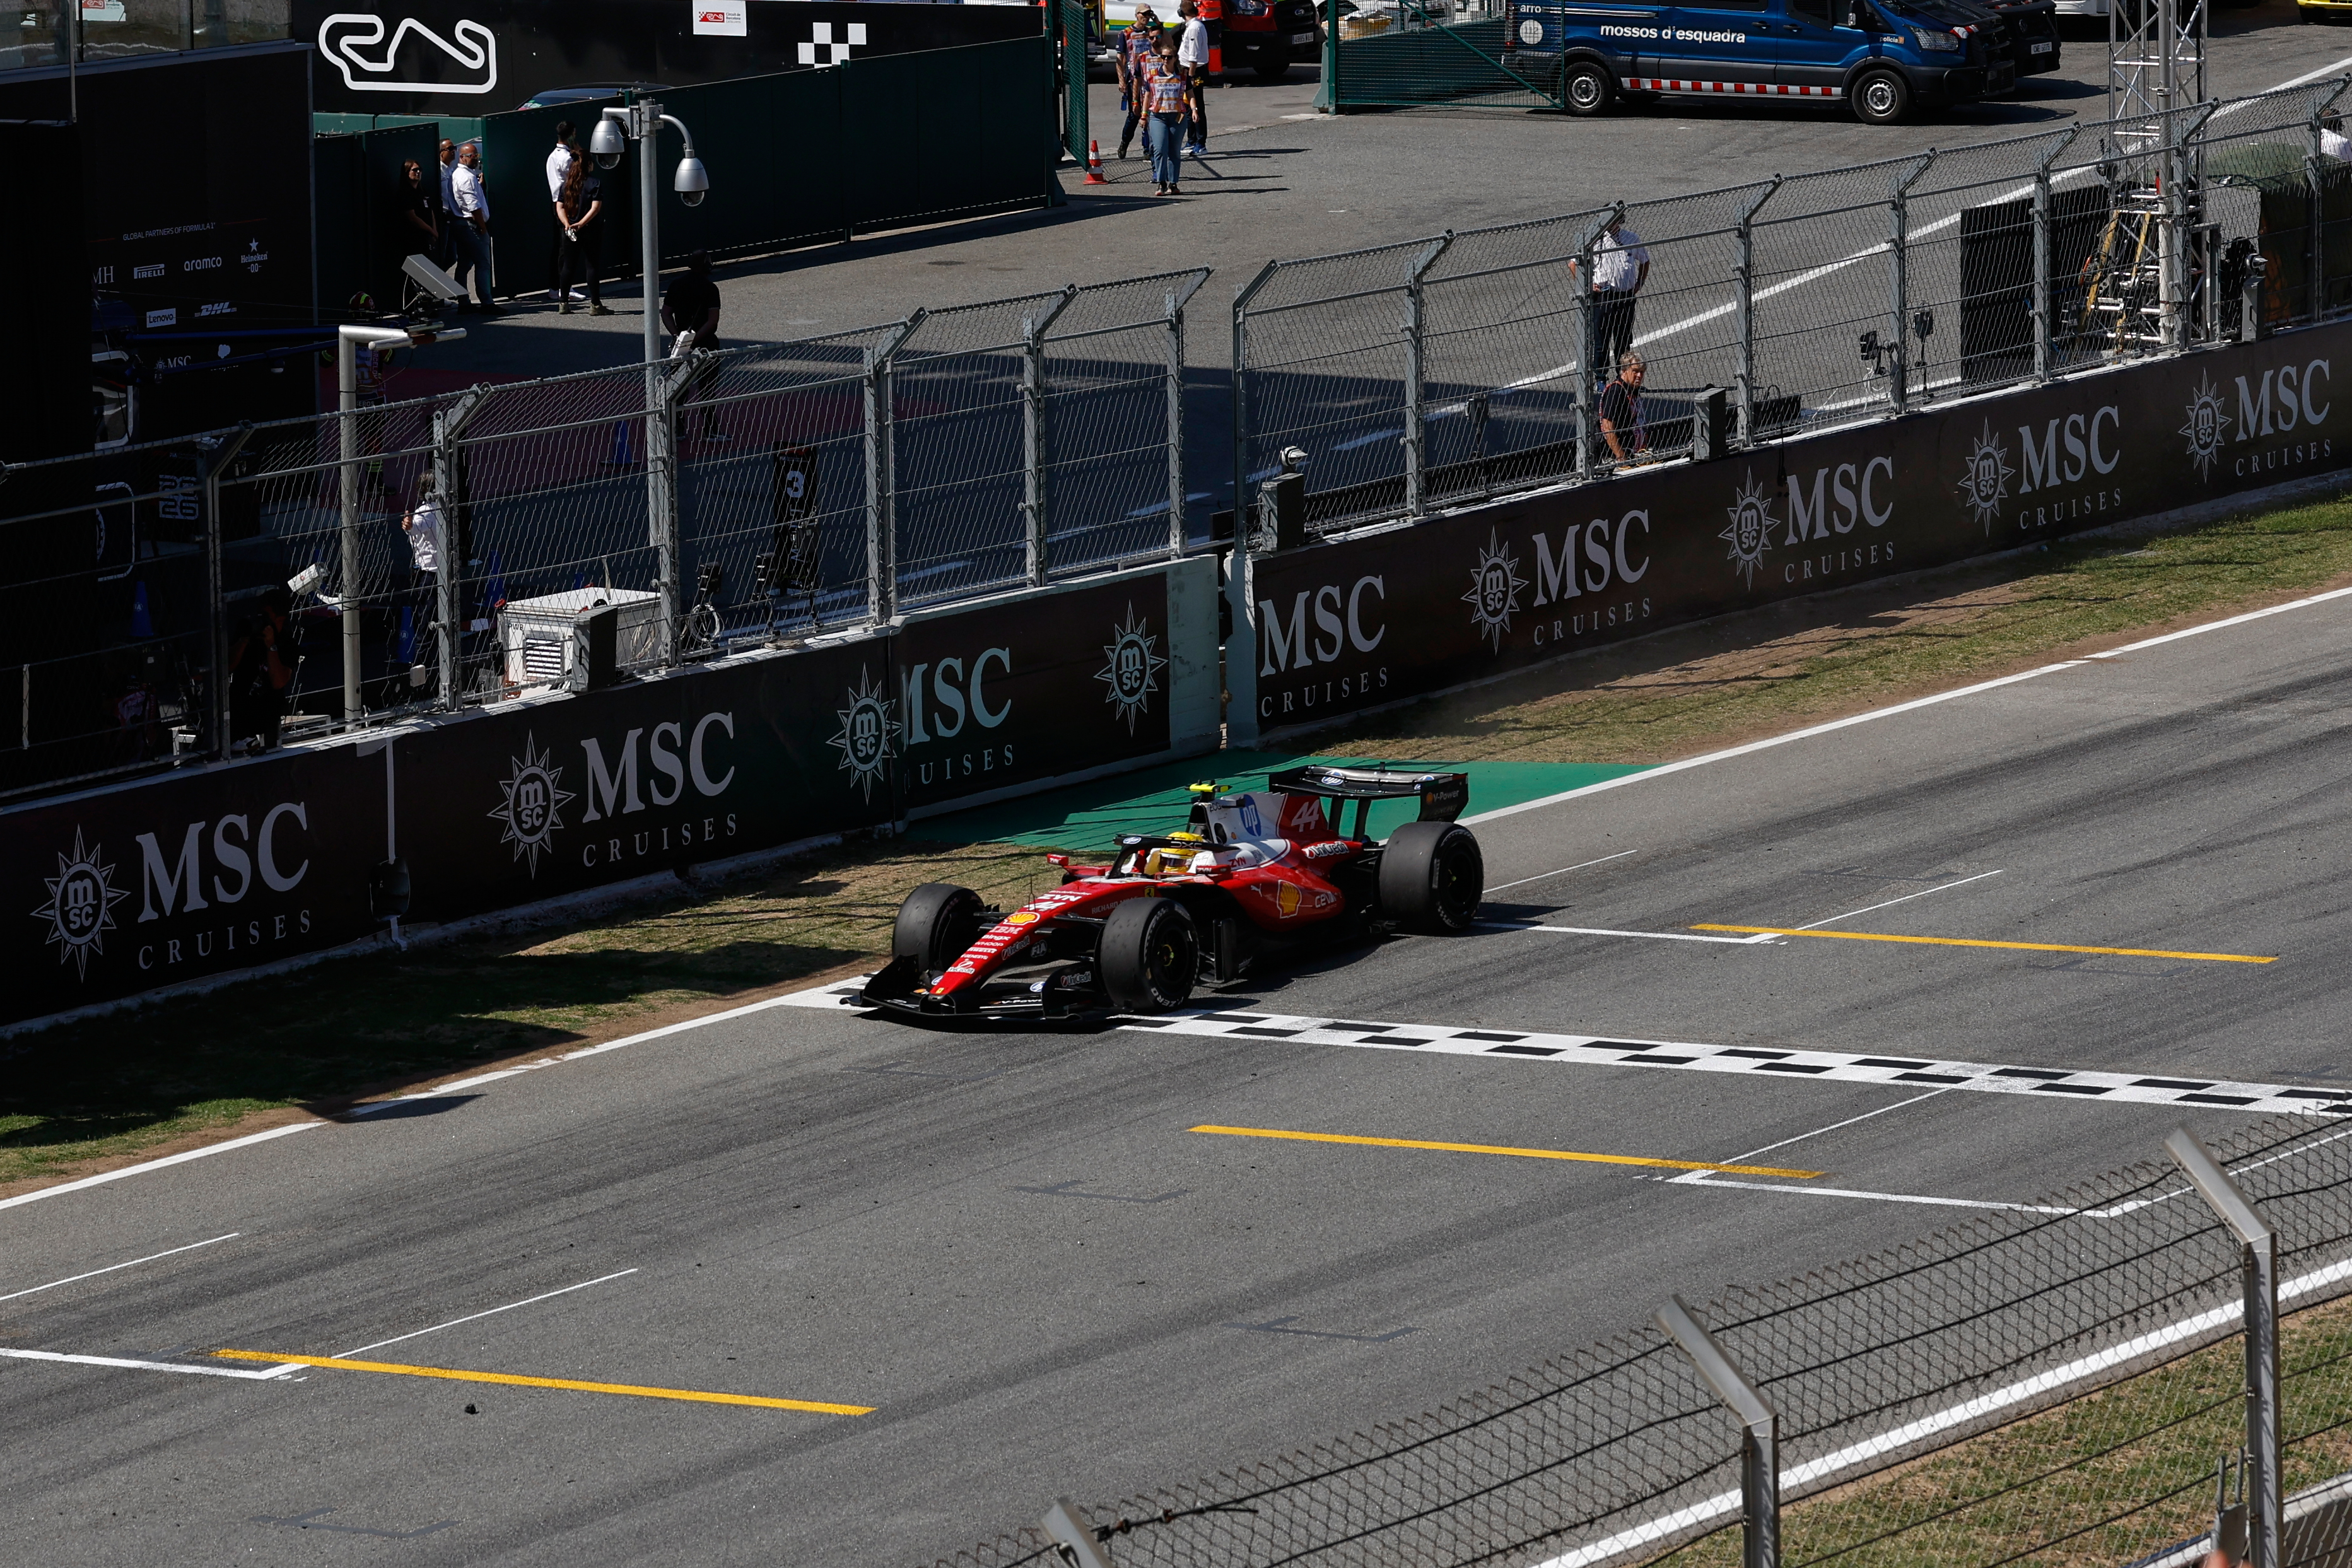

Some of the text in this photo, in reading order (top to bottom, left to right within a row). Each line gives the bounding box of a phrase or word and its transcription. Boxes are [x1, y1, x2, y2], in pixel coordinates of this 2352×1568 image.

[1520, 4, 1542, 13] arro
[1600, 24, 1746, 43] mossos d'esquadra
[123, 232, 144, 241] GLOBAL
[145, 228, 174, 238] PARTNERS
[174, 226, 182, 234] OF
[183, 223, 209, 233] FORMULA
[134, 264, 165, 279] PIRELLI
[184, 256, 222, 272] aramco
[149, 313, 173, 324] Lenovo
[200, 301, 231, 316] DHL
[2235, 360, 2329, 442] MSC
[2018, 406, 2119, 494] MSC
[2236, 440, 2330, 476] CRUISES
[787, 471, 804, 498] 3
[1784, 456, 1893, 546] MSC
[2020, 489, 2120, 530] CRUISES
[1532, 509, 1649, 607] MSC
[1784, 542, 1893, 583] CRUISES
[1259, 575, 1384, 677] MSC
[1534, 598, 1650, 645] CRUISES
[1261, 667, 1388, 717] CRUISES
[581, 712, 735, 823] MSC
[920, 744, 1014, 785] UISES
[1433, 790, 1460, 802] V-Power
[1243, 804, 1258, 836] hp
[1291, 799, 1320, 832] 44
[583, 814, 736, 867] CRUISES
[1171, 841, 1202, 849] DXC
[1311, 841, 1349, 857] UniCredit
[136, 802, 308, 923] MSC
[1228, 857, 1247, 868] ZYN
[1037, 894, 1082, 902] ZYN
[139, 910, 310, 969] CRUISES
[988, 926, 1024, 935] IBM
[1009, 935, 1030, 957] UniCredit
[1032, 942, 1046, 955] FIA
[1067, 971, 1091, 986] UniCredit
